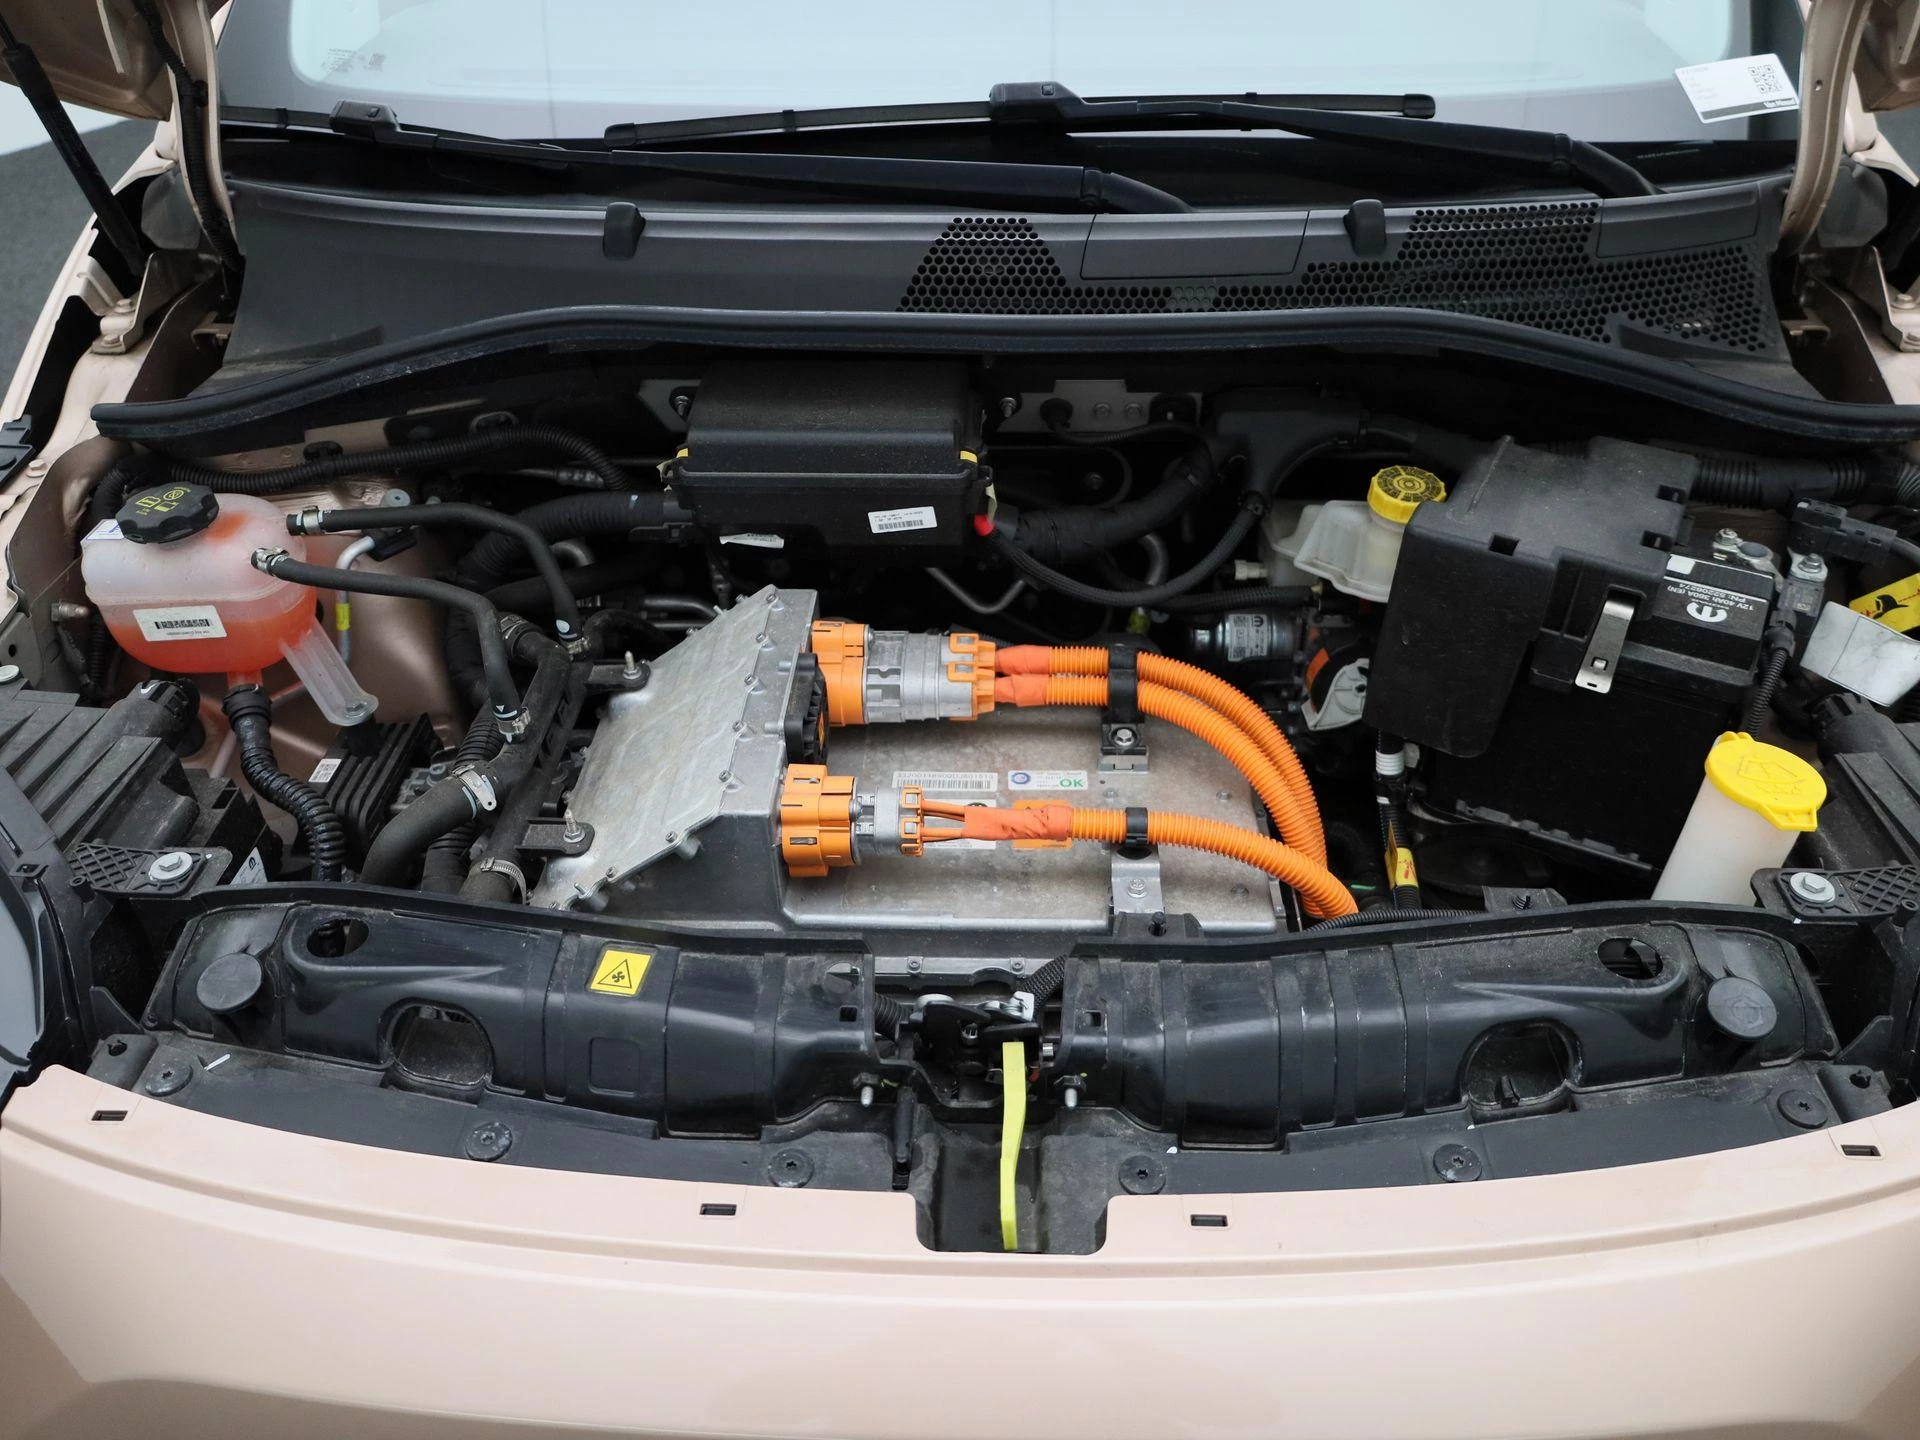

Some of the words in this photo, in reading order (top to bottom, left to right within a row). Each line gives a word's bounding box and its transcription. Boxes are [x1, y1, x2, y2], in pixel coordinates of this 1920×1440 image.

[1712, 597, 1736, 607] 40Ah
[1736, 603, 1754, 611] 12V
[1059, 778, 1084, 788] OK
